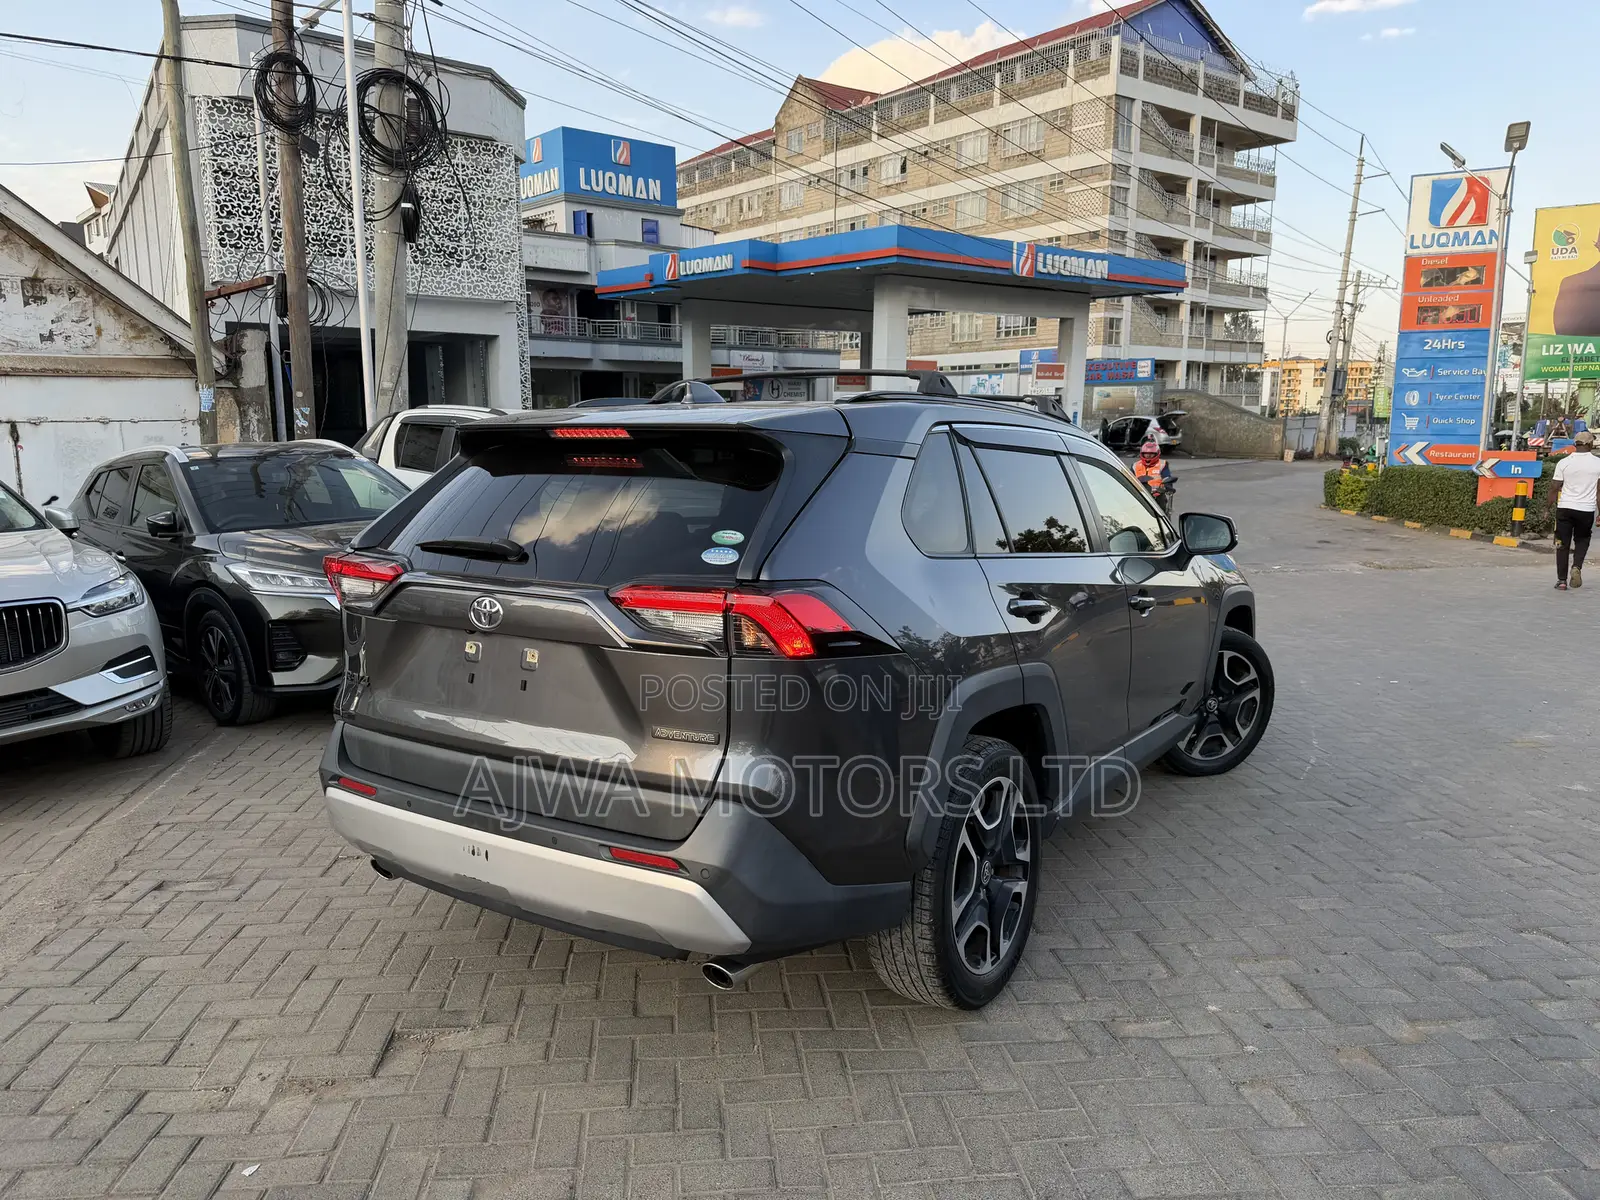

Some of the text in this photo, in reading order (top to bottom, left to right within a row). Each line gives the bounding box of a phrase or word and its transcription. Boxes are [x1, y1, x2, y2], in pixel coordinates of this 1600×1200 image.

[520, 167, 560, 200] UQMAN
[579, 167, 661, 201] LUQMAN
[1409, 229, 1499, 250] LUQMAN
[1551, 246, 1578, 256] UDA
[680, 253, 733, 276] LUQMAN
[1036, 252, 1109, 279] LUQMAN
[1421, 257, 1449, 266] Diesel
[1418, 294, 1460, 303] Unleaded
[1423, 338, 1466, 351] 24Hrs
[1542, 344, 1564, 356] LIZ
[1561, 355, 1600, 363] ELZABET
[1086, 360, 1137, 371] XECUTIVE
[1106, 371, 1135, 381] WASH
[1437, 367, 1470, 376] Service
[1435, 393, 1453, 401] Tyre
[1456, 417, 1476, 425] Shop
[1429, 450, 1476, 459] Restaurant
[1511, 464, 1522, 475] In
[654, 727, 716, 743] ADVENTURE
